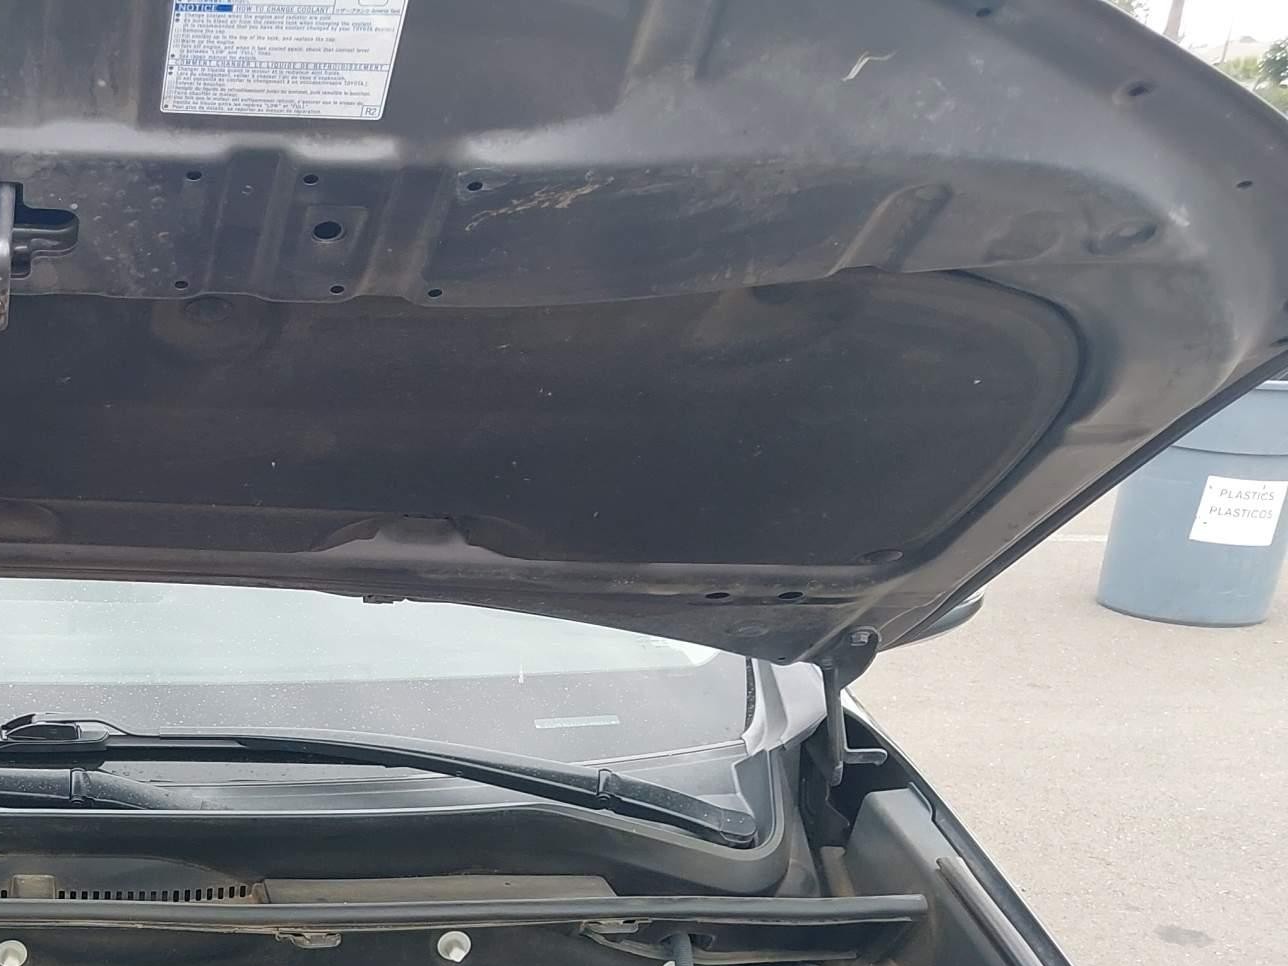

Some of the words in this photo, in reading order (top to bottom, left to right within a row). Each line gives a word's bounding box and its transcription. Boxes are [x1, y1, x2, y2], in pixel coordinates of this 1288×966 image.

[297, 6, 330, 14] COOLANT
[365, 107, 377, 116] R2
[1219, 488, 1275, 501] PLASTICS
[1209, 506, 1273, 519] PLASTICOS
